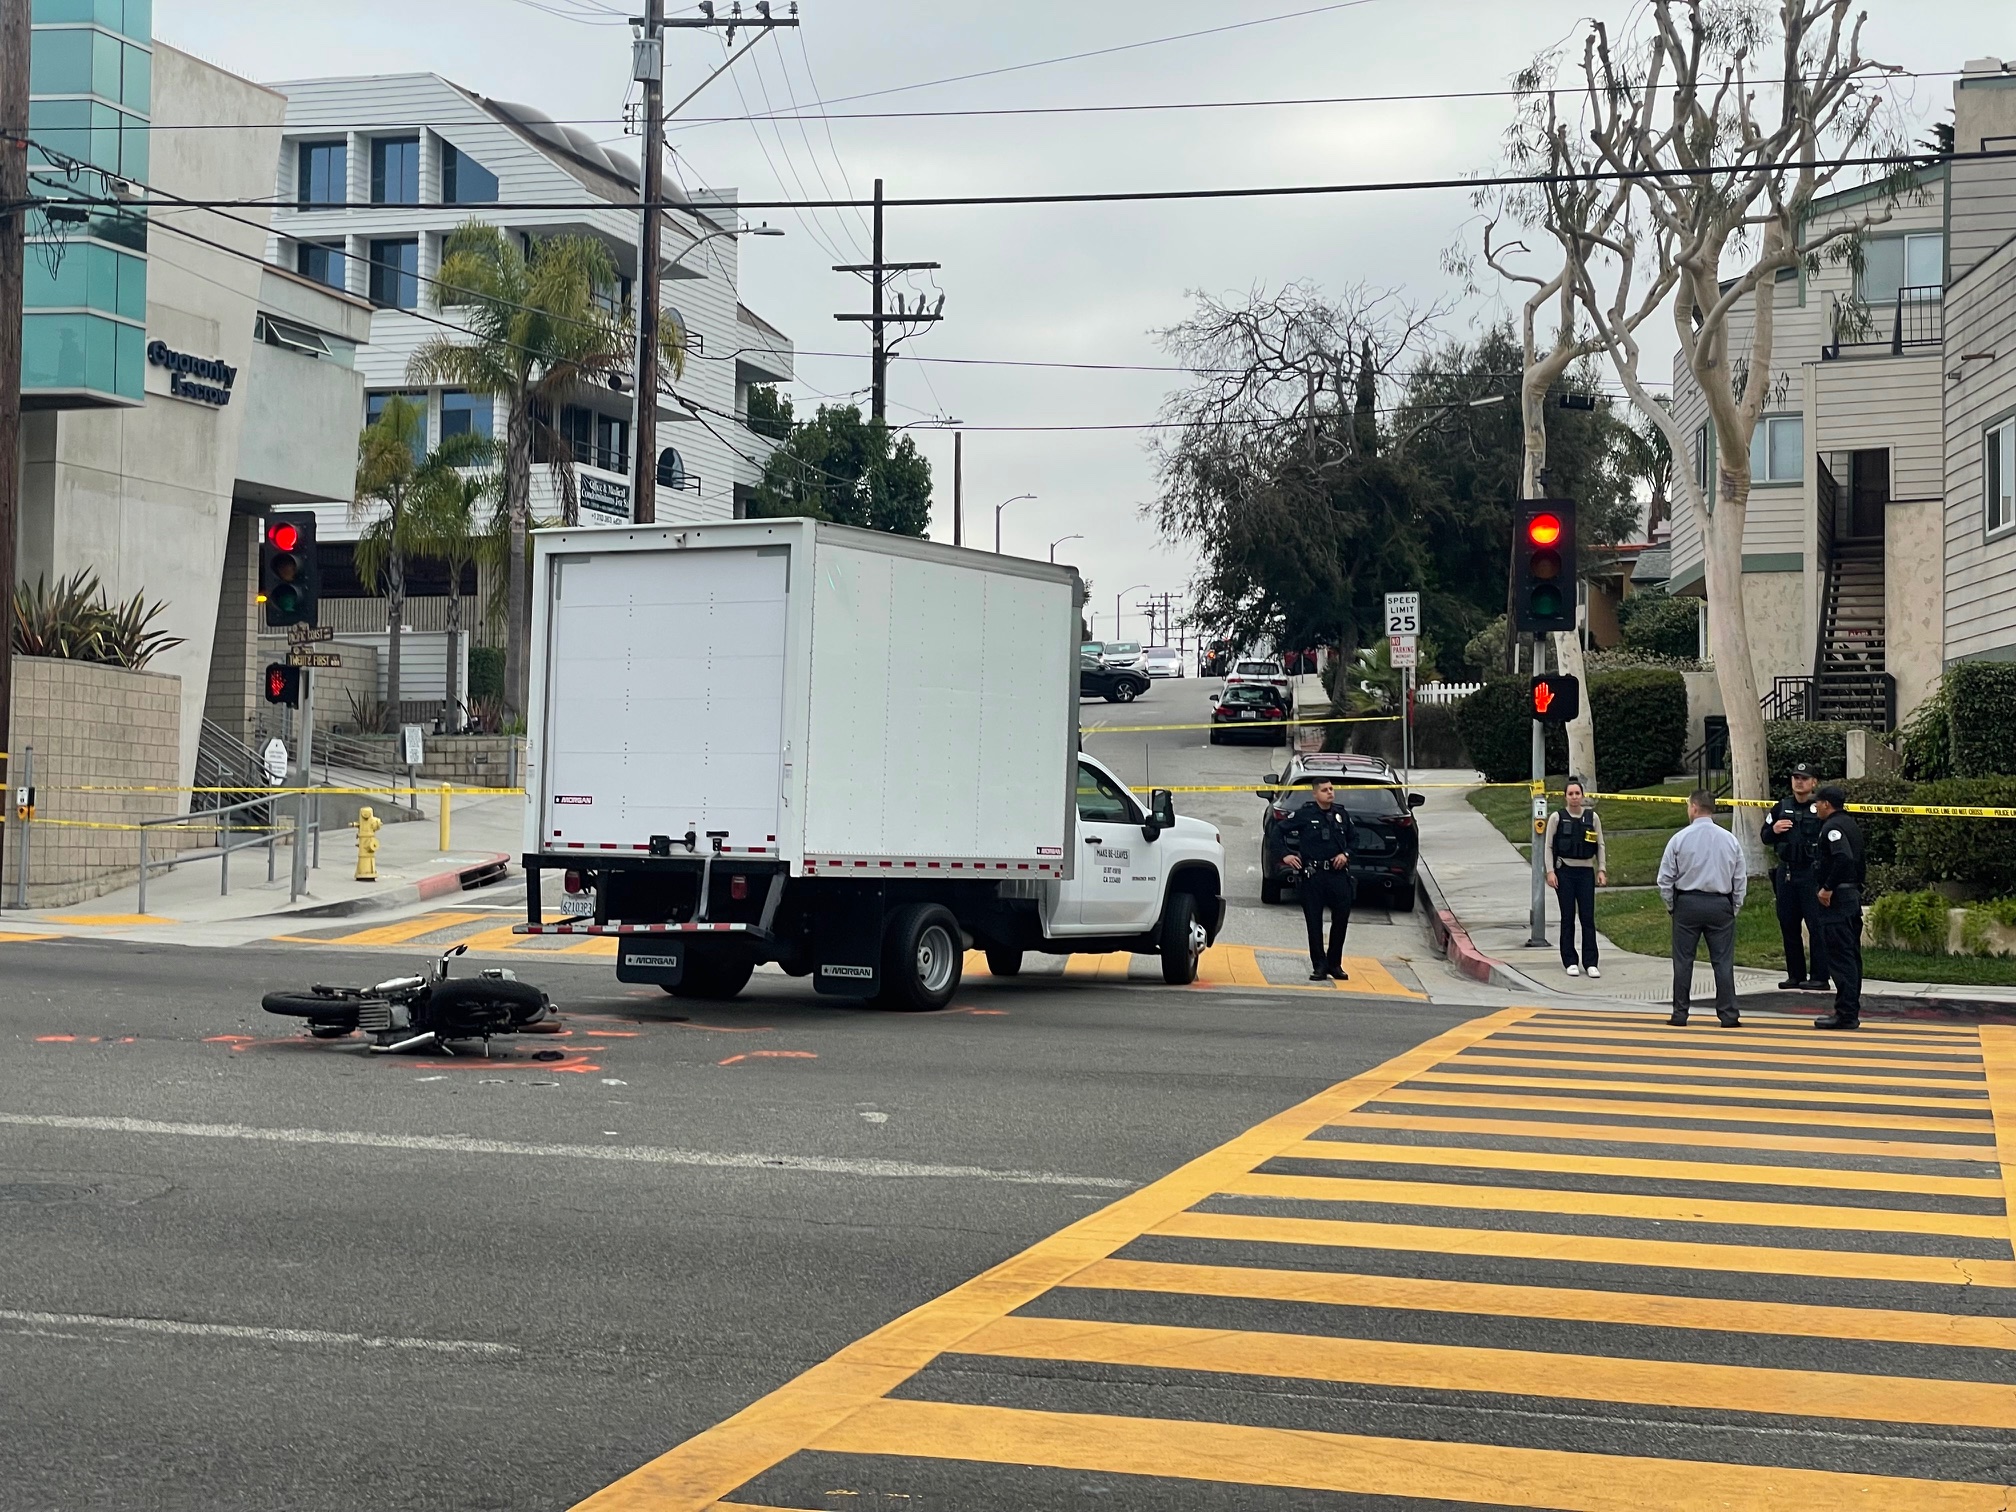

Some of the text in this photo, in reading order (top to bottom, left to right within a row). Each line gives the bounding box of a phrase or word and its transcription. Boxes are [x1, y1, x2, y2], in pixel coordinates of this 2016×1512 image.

[147, 340, 238, 390] Guaranty
[170, 371, 231, 405] Escrow
[1390, 606, 1415, 614] LIMIT
[1390, 616, 1416, 631] 25
[1391, 637, 1400, 646] NO
[313, 655, 330, 666] FIRST
[561, 796, 592, 804] MORGAN
[1096, 849, 1128, 859] MAKE BE-LEAVES
[635, 956, 675, 966] MORGAN
[831, 966, 871, 977] MORGAN
